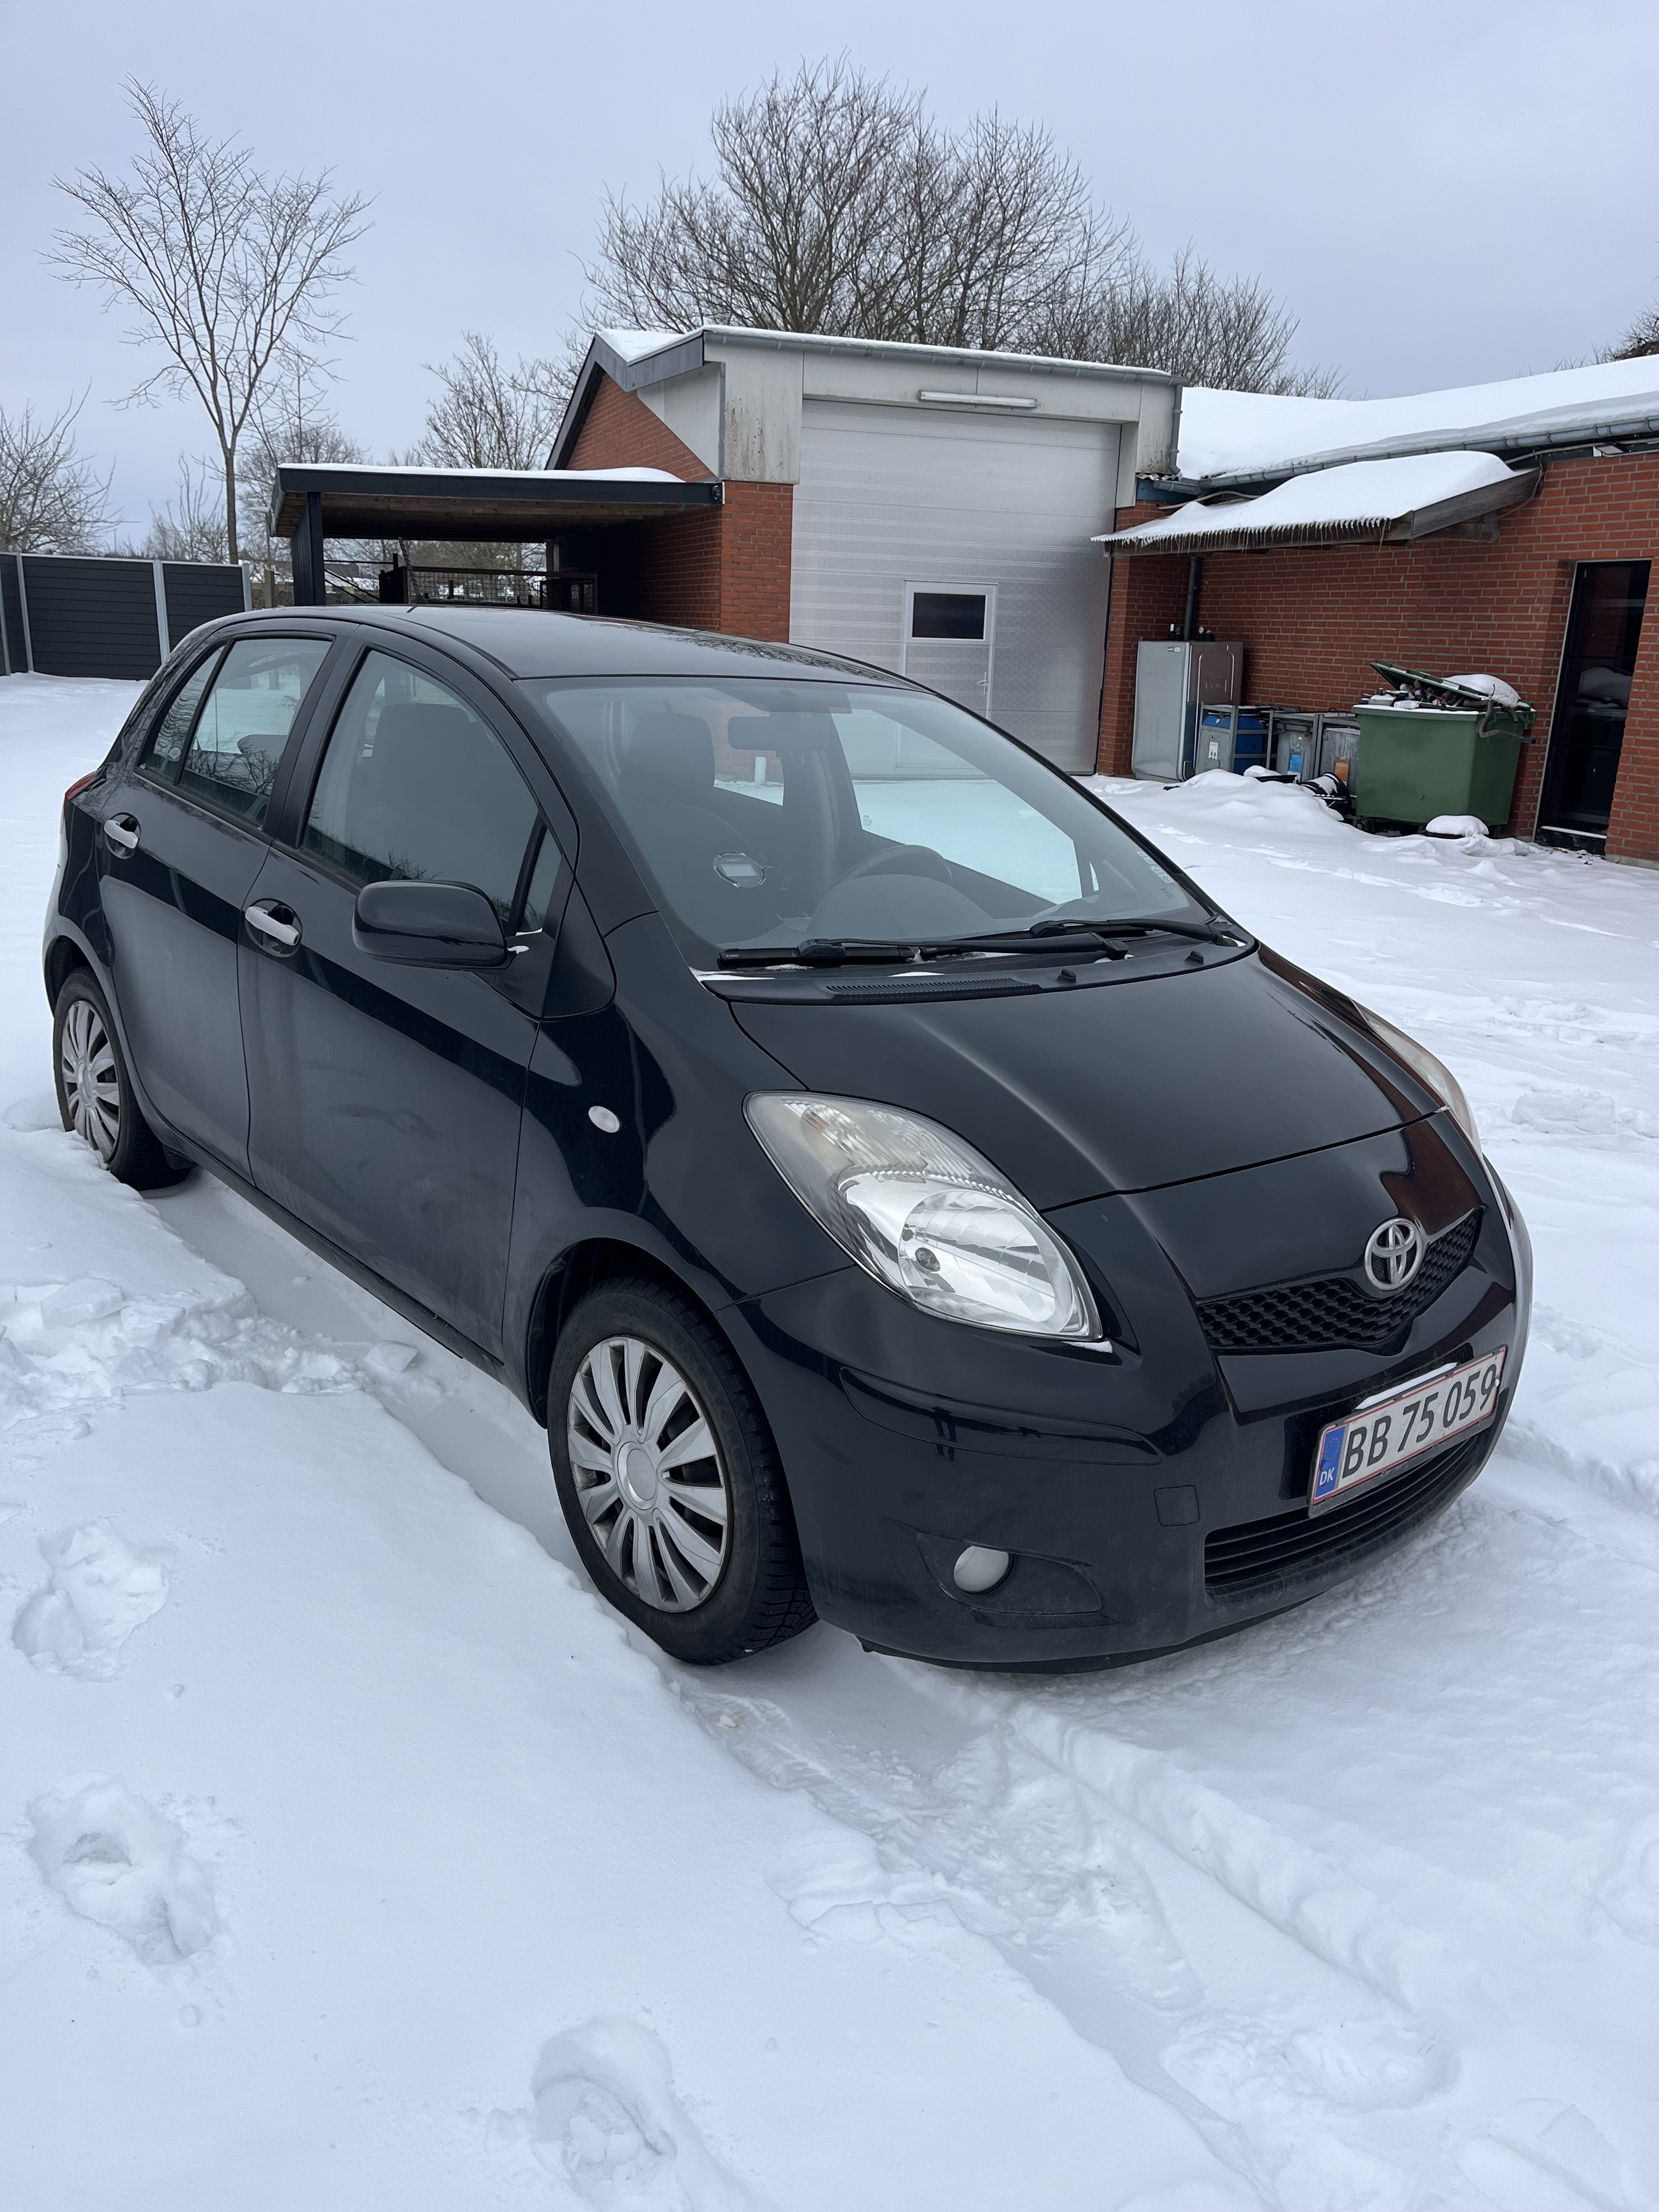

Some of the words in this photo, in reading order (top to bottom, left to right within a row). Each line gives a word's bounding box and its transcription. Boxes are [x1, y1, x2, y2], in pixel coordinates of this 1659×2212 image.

[1342, 1415, 1392, 1479] BB
[1397, 1391, 1440, 1453] 75
[1443, 1364, 1497, 1429] 059
[1319, 1466, 1335, 1486] DK
